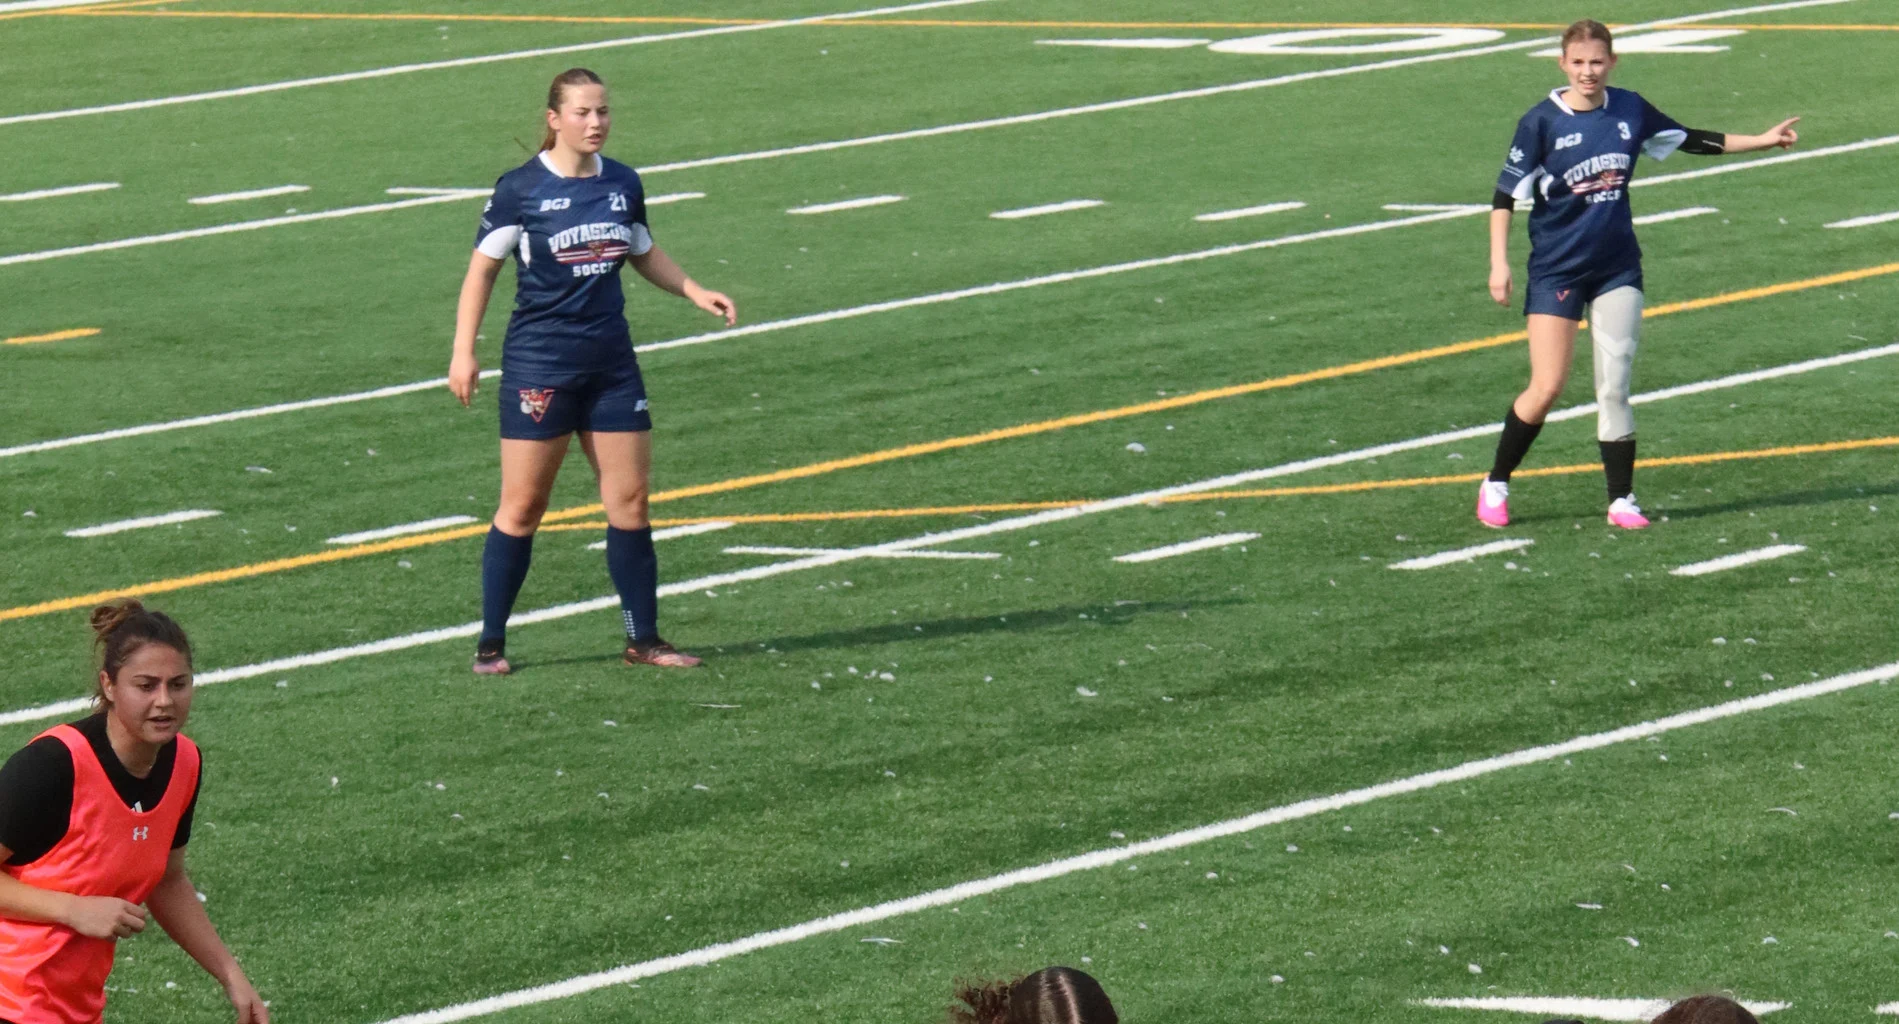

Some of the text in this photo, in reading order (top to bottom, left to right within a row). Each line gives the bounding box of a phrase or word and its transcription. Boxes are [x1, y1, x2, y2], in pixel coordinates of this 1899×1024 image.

[1617, 122, 1632, 140] 3
[1555, 132, 1582, 150] BG3
[539, 197, 571, 212] BG3
[608, 192, 627, 211] 21
